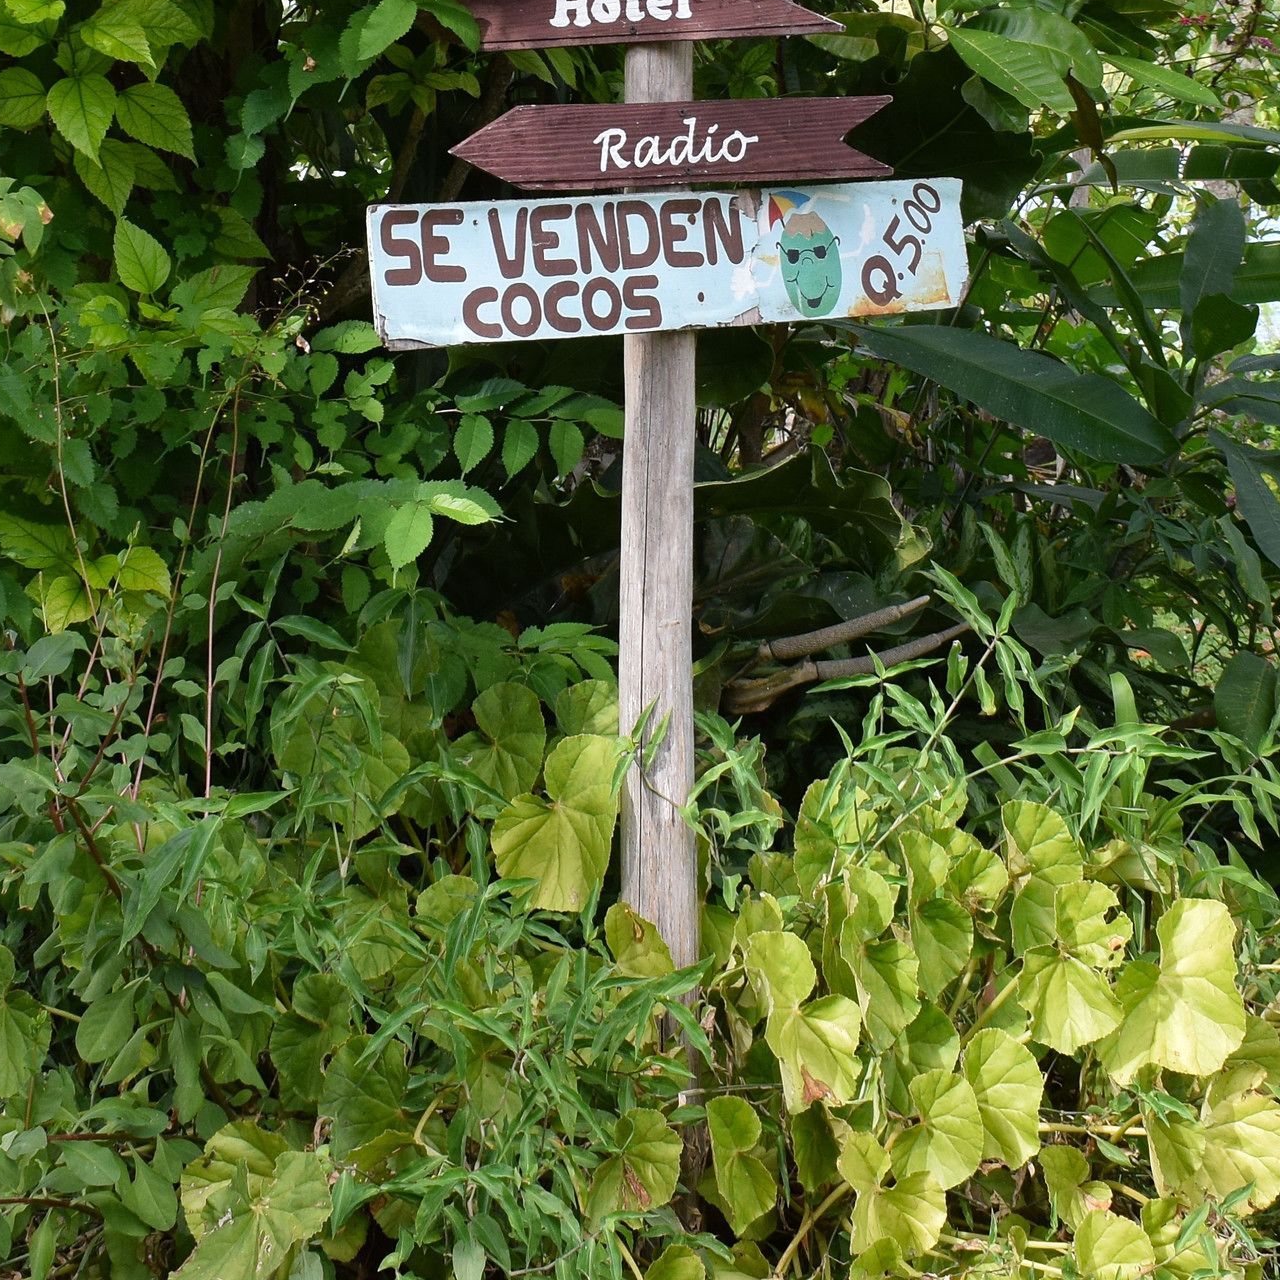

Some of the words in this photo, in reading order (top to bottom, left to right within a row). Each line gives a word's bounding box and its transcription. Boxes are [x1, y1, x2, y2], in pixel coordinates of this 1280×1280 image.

[593, 117, 759, 172] Radio
[380, 208, 468, 287] SE
[487, 195, 746, 279] VENDEN
[462, 275, 663, 339] COCOS
